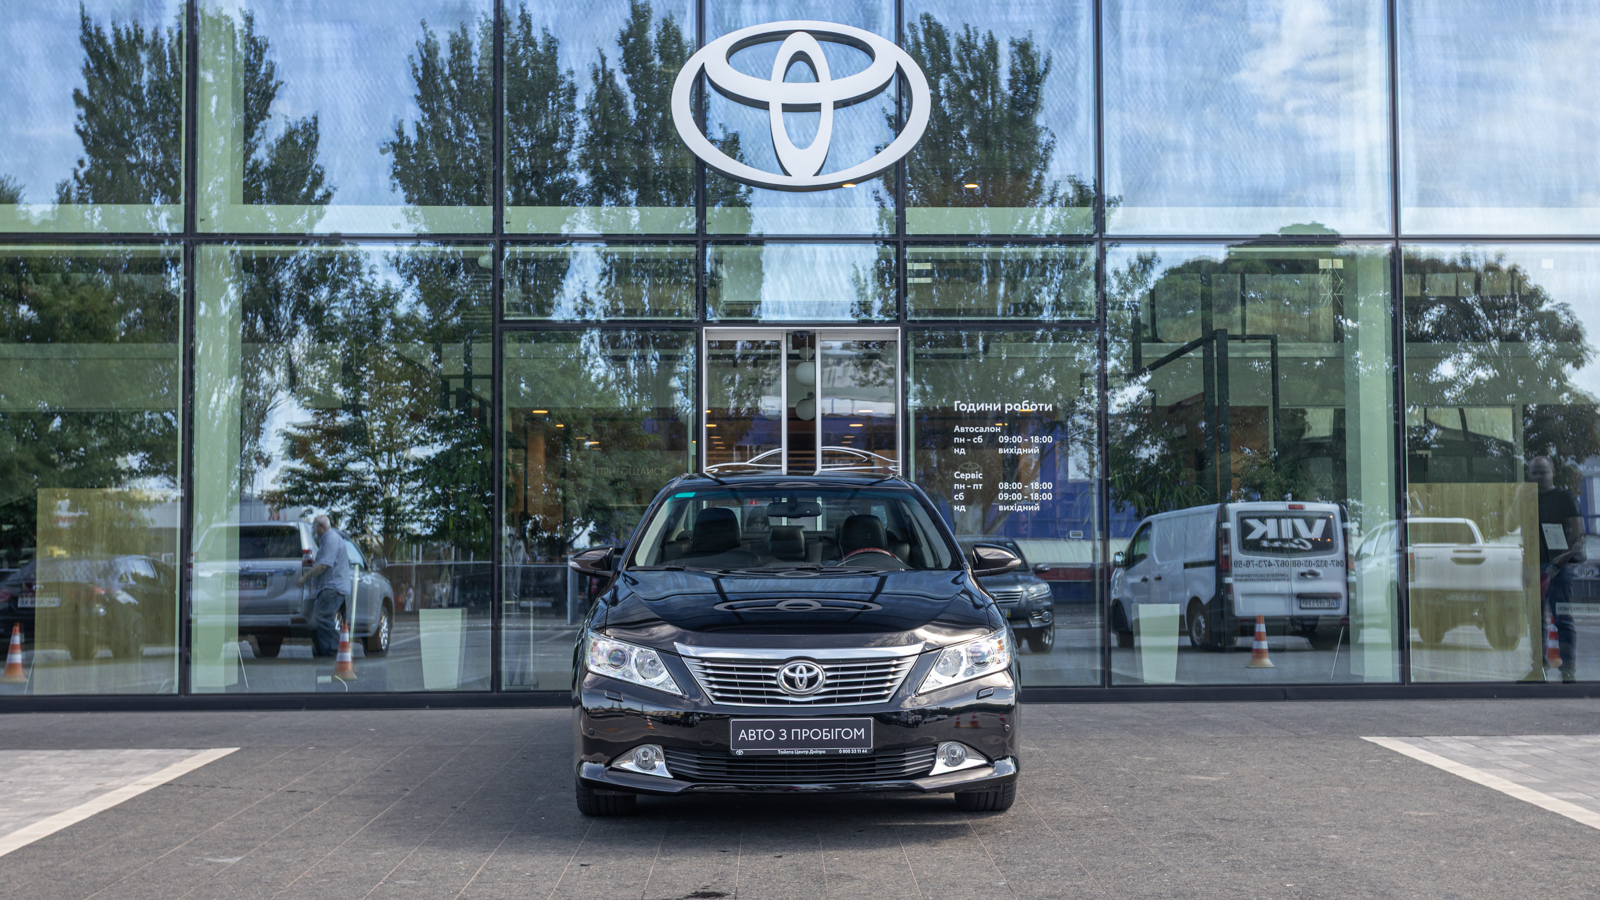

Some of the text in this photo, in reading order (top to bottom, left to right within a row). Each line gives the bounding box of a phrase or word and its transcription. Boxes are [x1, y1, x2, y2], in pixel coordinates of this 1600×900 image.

[954, 400, 1053, 413] Години роботи
[953, 425, 1001, 433] Автосалон
[972, 435, 983, 443] сб
[998, 435, 1022, 443] 09:00
[1030, 435, 1053, 443] 18:00
[998, 447, 1040, 455] вихідний
[953, 471, 983, 481] Сервіс
[998, 482, 1022, 490] 08:00
[1030, 482, 1053, 490] 18:00
[953, 492, 965, 500] сб
[998, 493, 1022, 501] 09:00
[1030, 493, 1053, 501] 18:00
[998, 504, 1040, 512] вихідний
[738, 727, 865, 741] АВТО З ПРОБІГОМ
